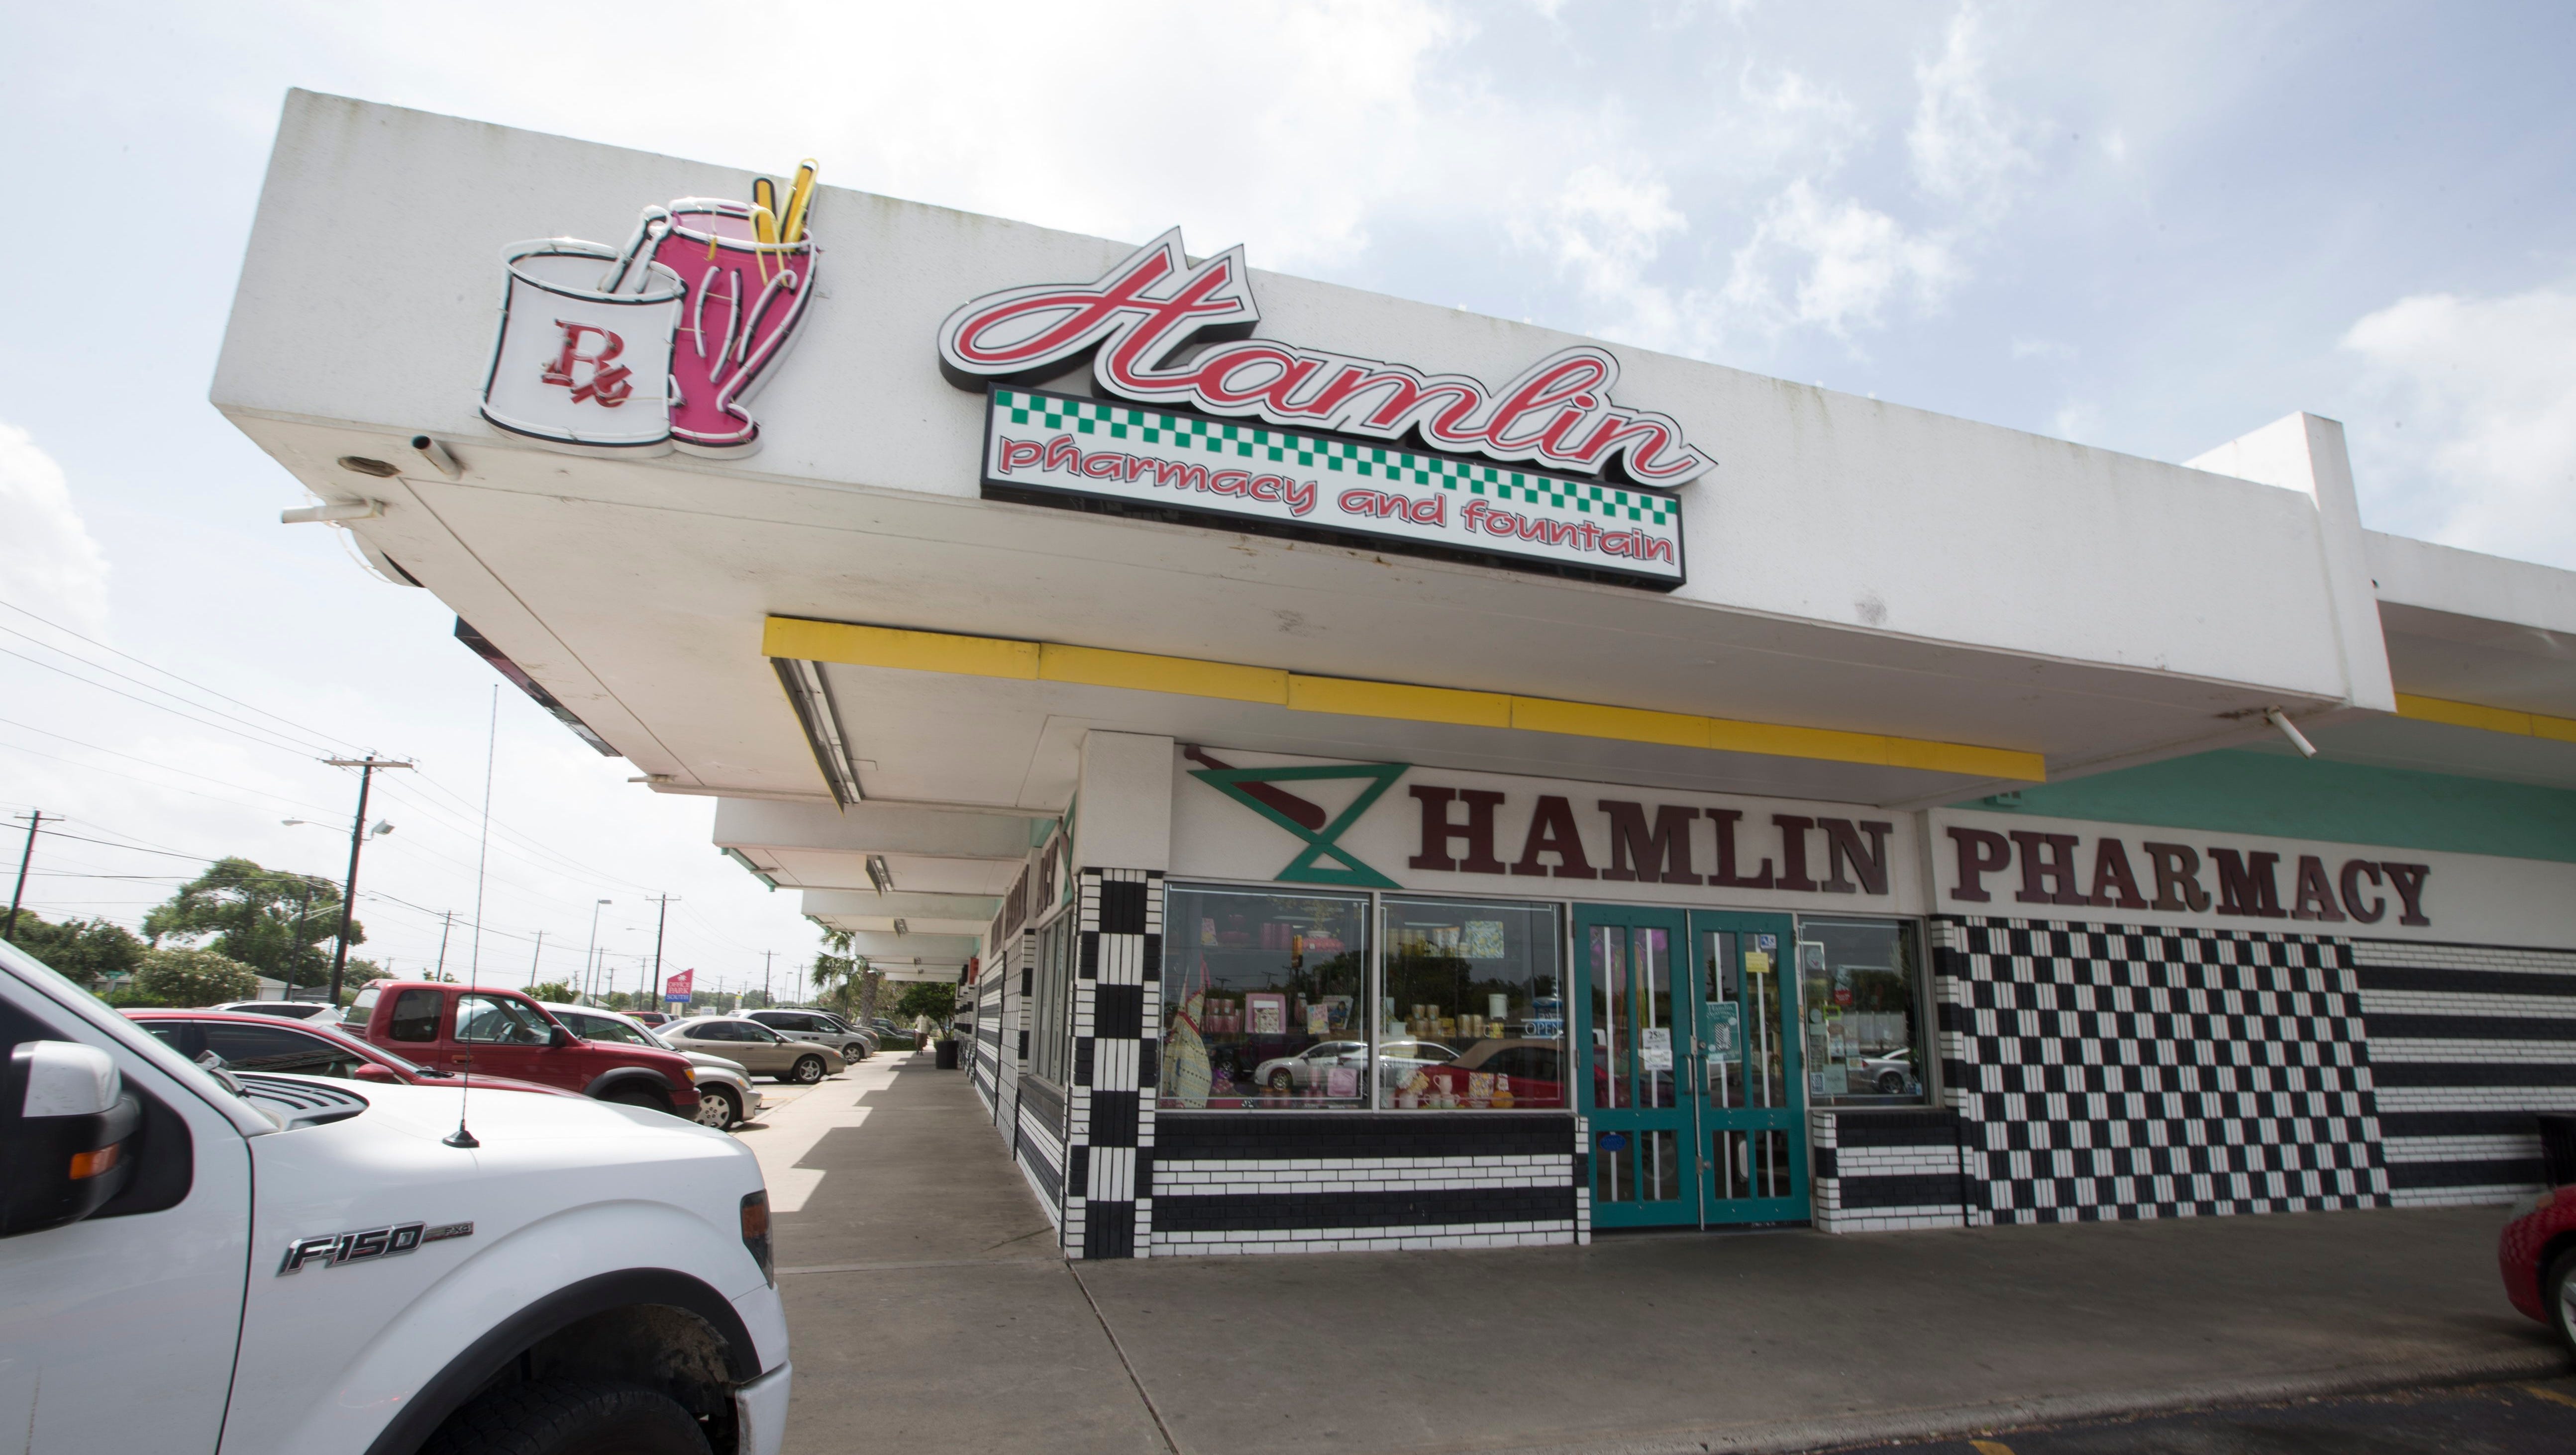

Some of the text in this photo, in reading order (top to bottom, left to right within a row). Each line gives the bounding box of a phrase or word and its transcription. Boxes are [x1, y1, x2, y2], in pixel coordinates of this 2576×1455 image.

[951, 242, 1700, 479] Hamlin
[999, 434, 1675, 565] pharmacy and fountain
[1409, 784, 2431, 927] HAMLIN PHARMACY
[1525, 1022, 1562, 1035] OPEN
[276, 1220, 471, 1277] F-150 FX4
